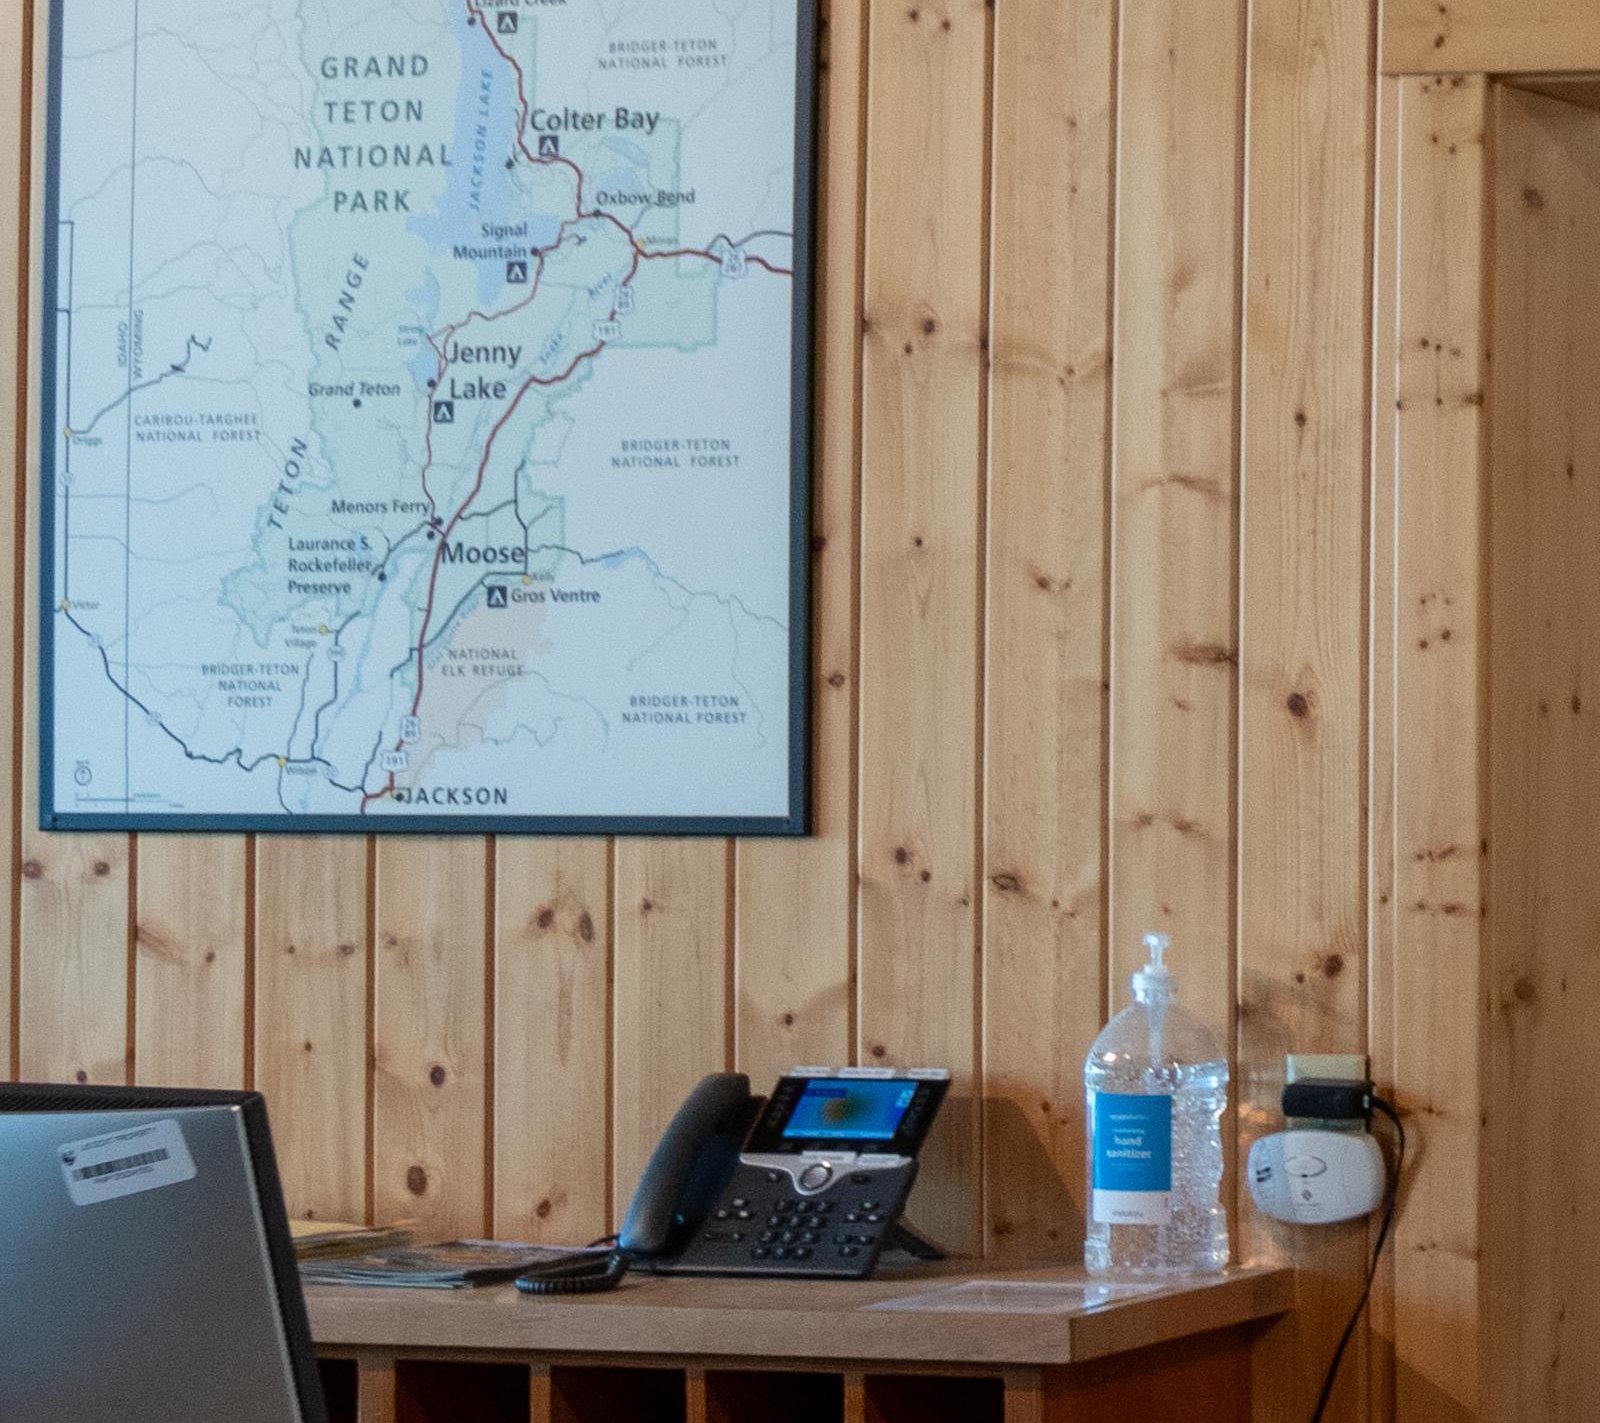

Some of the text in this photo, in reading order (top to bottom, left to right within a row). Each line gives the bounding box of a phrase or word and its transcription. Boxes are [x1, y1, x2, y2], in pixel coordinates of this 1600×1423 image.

[320, 54, 429, 79] GRAND
[323, 100, 424, 124] TETON
[531, 106, 660, 135] Colter Bay
[294, 143, 453, 169] NATIONAL
[333, 190, 410, 213] PARK
[595, 188, 696, 205] Oxbow Bend
[480, 222, 528, 240] Signal
[453, 245, 527, 261] Mountain
[326, 252, 369, 351] RANGE
[447, 342, 522, 369] Jenny
[449, 377, 507, 400] Lake
[267, 438, 309, 531] TETON
[331, 499, 431, 518] Menors Ferry
[287, 537, 355, 551] Laurance
[441, 542, 525, 565] Moose
[288, 558, 372, 573] Rockefeller
[287, 580, 351, 595] Preserve
[511, 589, 600, 604] Gros Ventre
[405, 786, 508, 805] JACKSON
